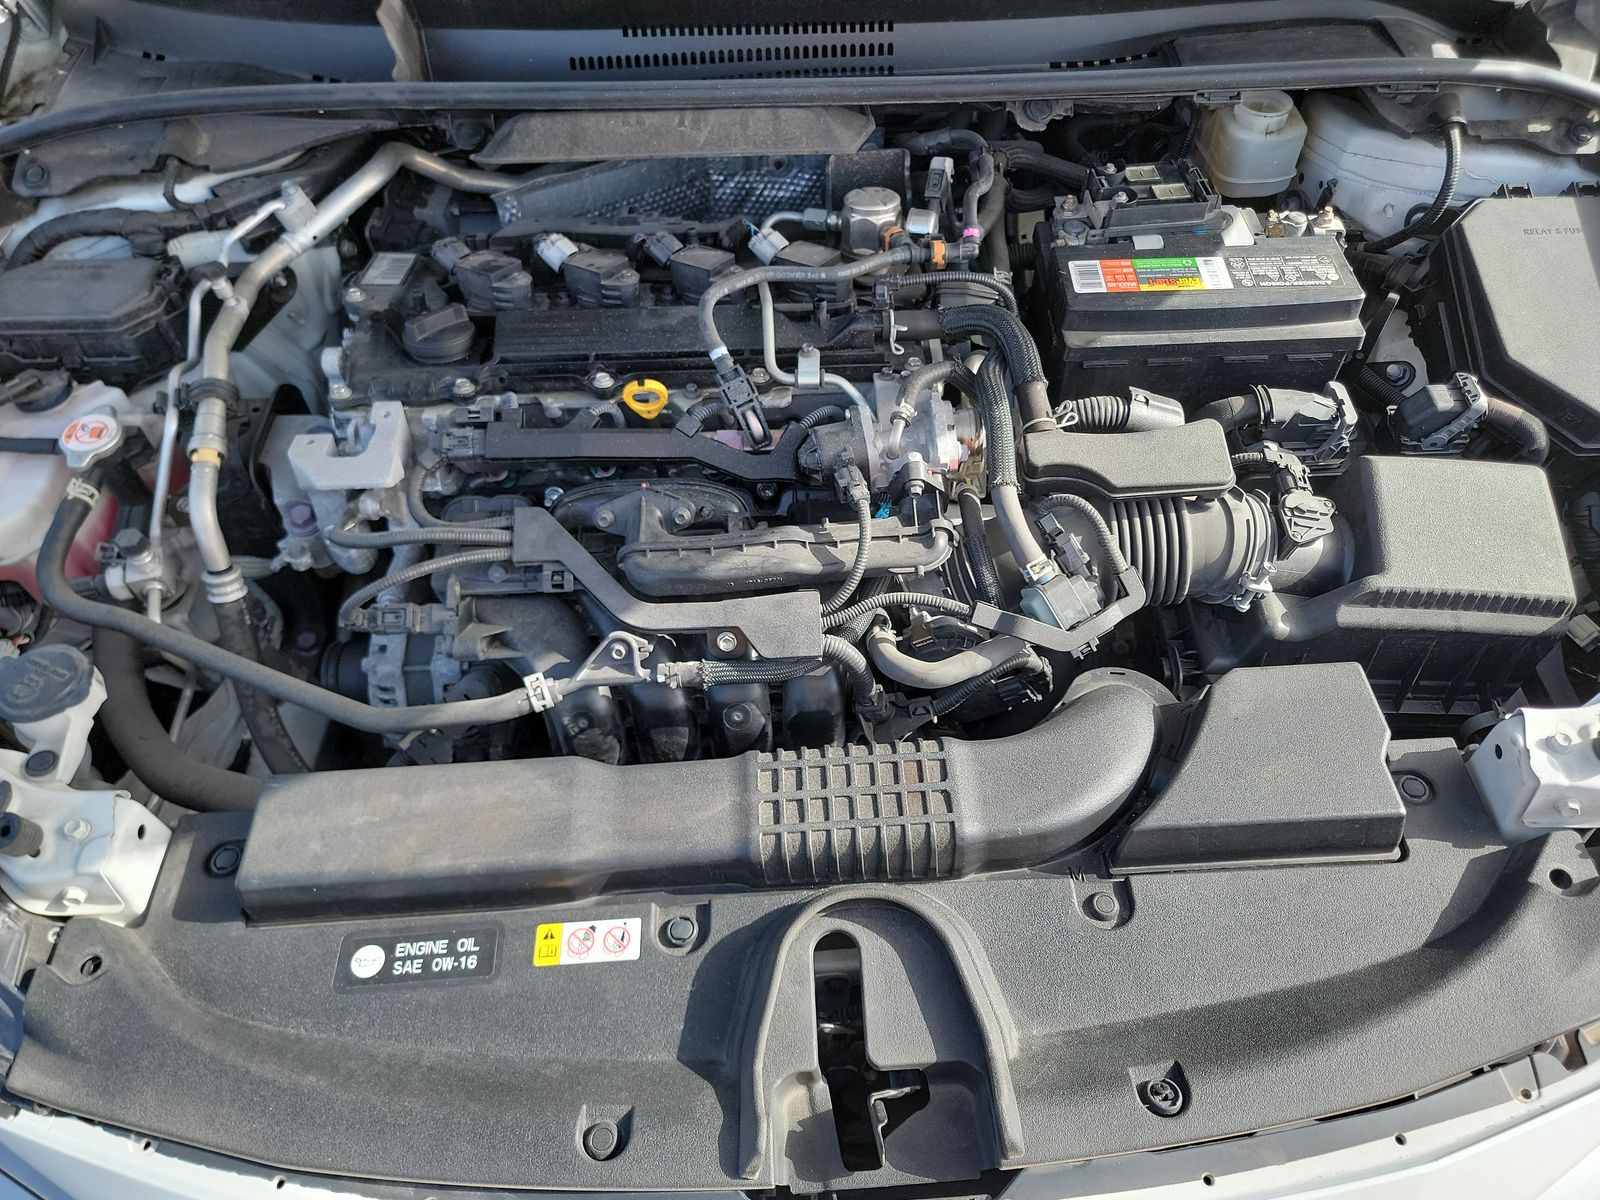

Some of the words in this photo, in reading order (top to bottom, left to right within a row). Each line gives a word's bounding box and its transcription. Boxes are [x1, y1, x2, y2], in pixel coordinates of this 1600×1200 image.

[1523, 228, 1552, 236] RELAY
[395, 940, 449, 957] ENGINE
[457, 937, 480, 953] OIL
[392, 959, 423, 975] SAE
[432, 955, 478, 972] 0W-16
